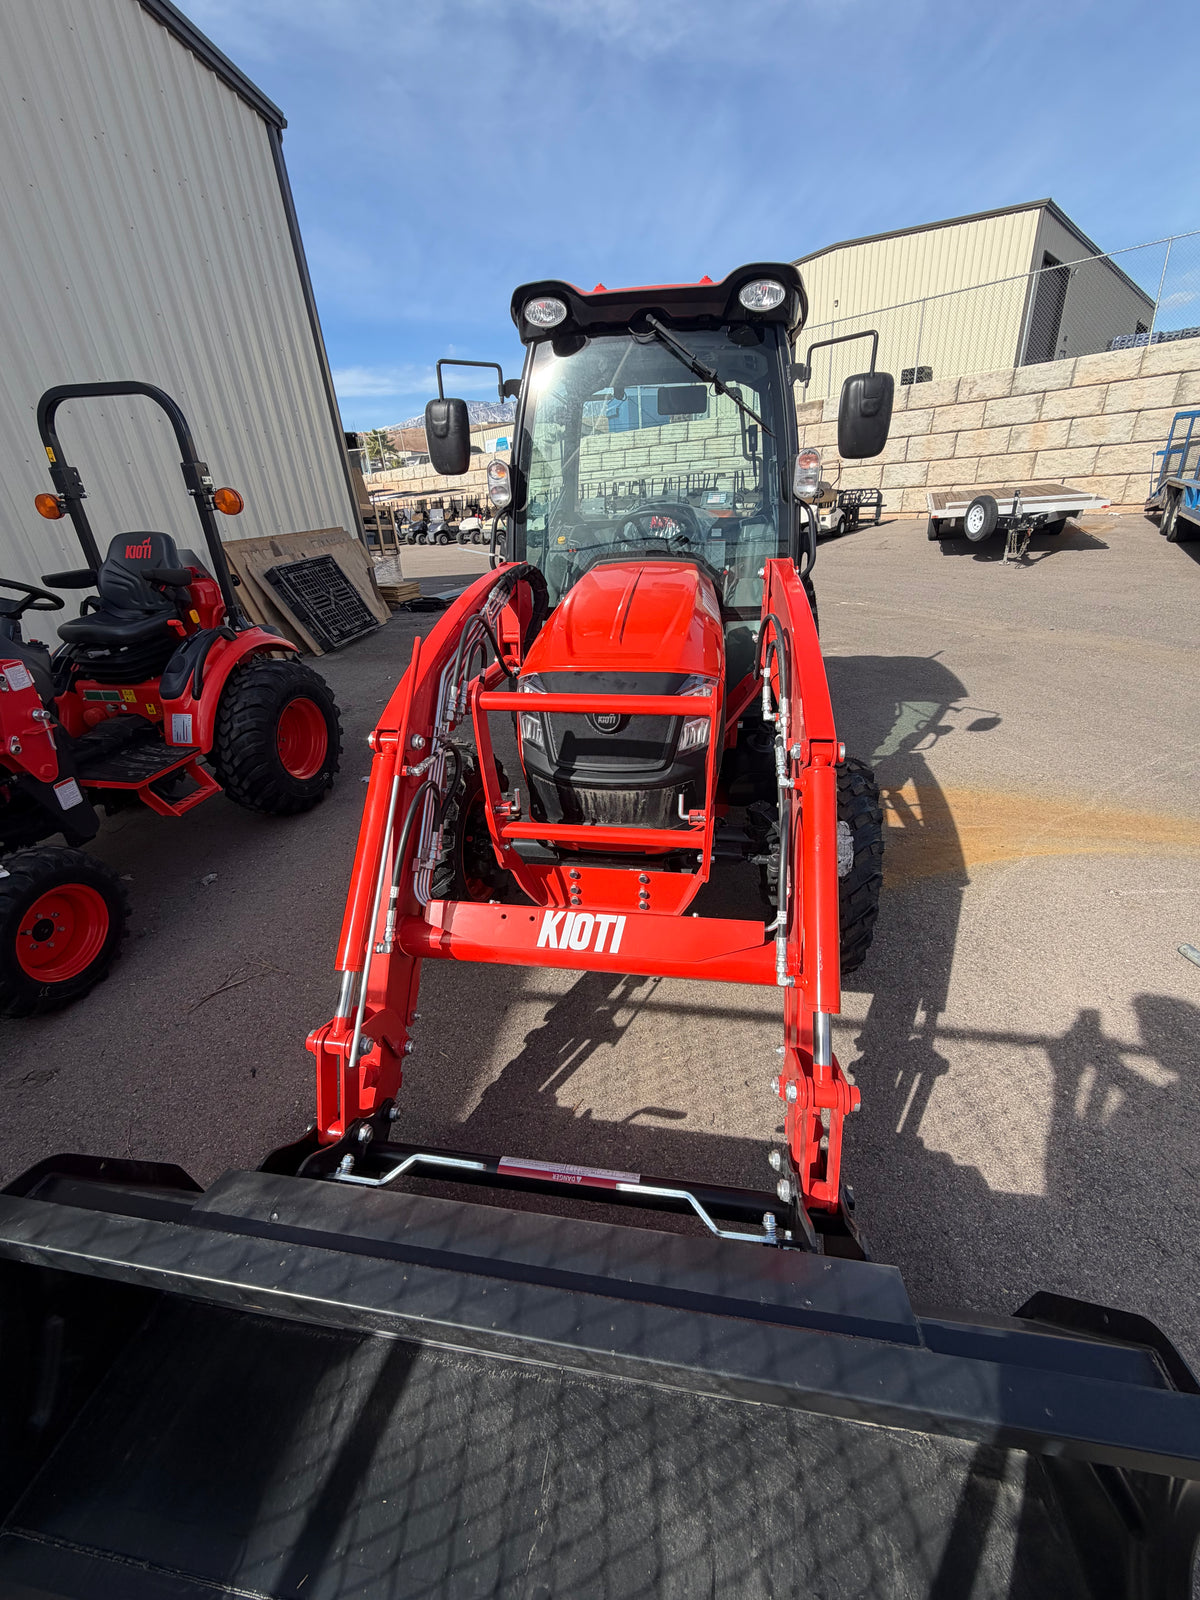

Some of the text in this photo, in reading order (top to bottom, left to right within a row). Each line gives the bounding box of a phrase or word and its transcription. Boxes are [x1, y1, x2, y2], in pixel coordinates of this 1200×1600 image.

[125, 544, 152, 559] KIOTI
[597, 716, 616, 724] KIOTI
[536, 910, 627, 954] KIOTI
[552, 1173, 576, 1183] DANGER
